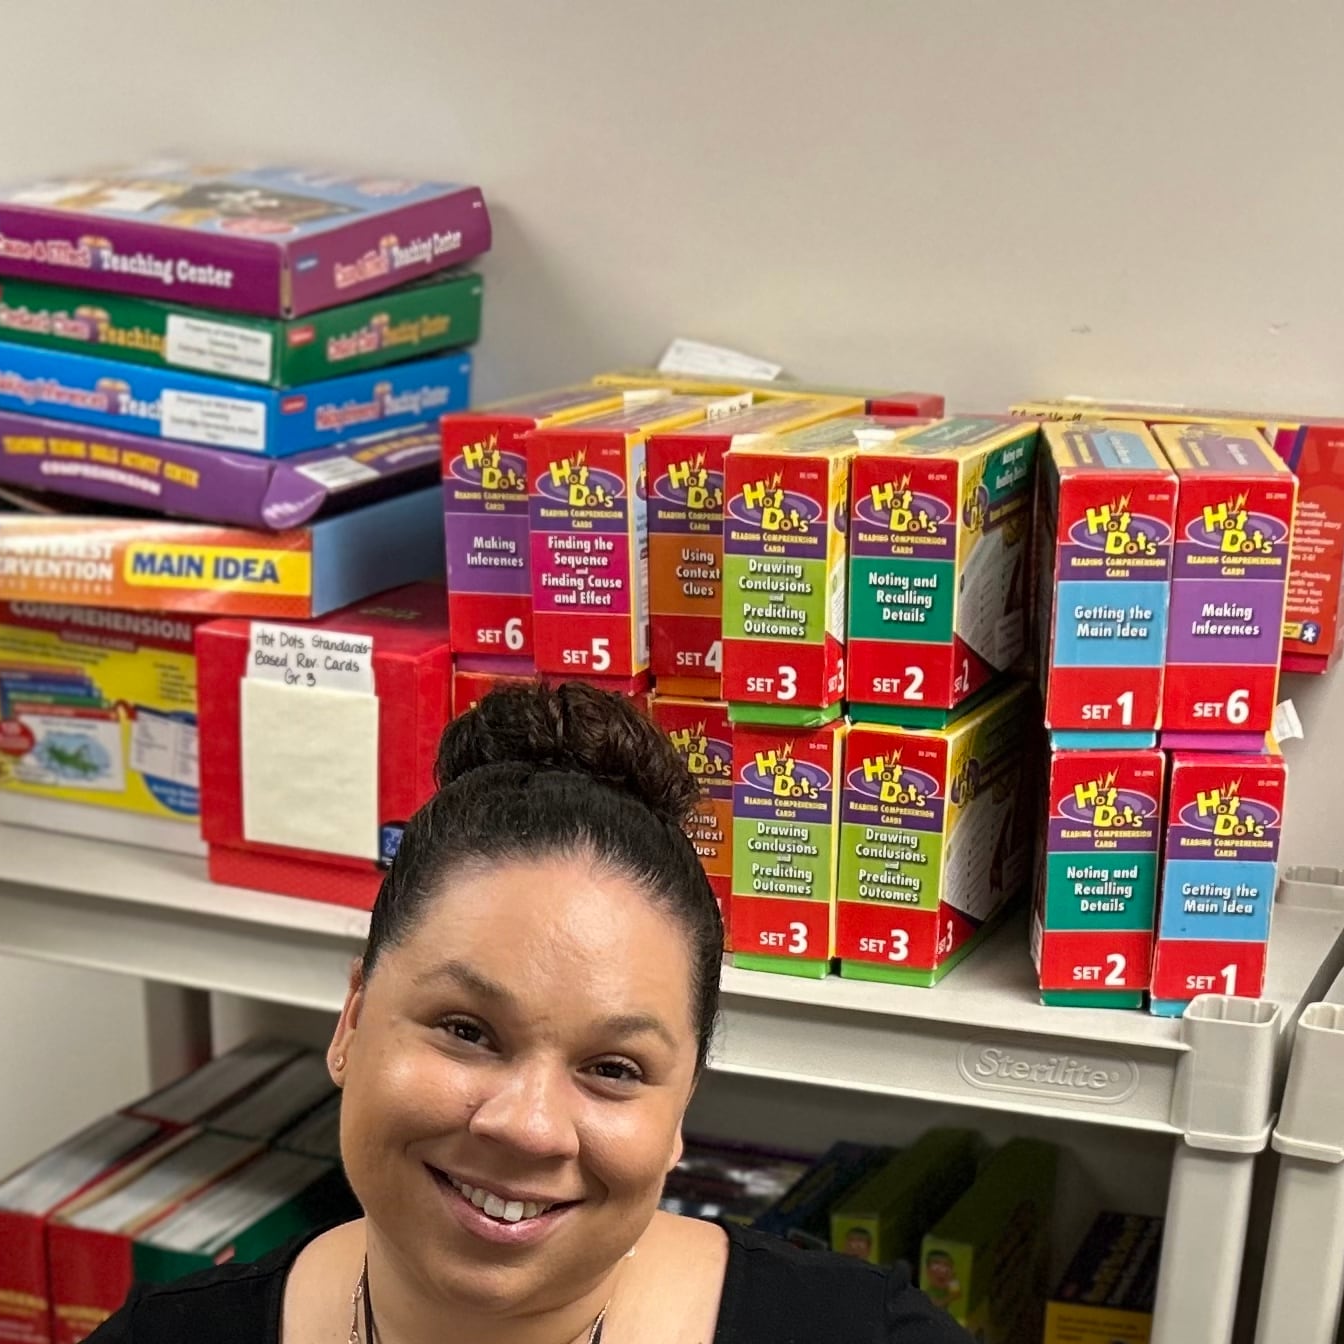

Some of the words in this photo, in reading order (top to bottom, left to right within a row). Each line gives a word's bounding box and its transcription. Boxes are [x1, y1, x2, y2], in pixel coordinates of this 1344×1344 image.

[132, 548, 203, 579] MAIN
[213, 555, 279, 584] IDEA
[748, 560, 802, 578] Drawing
[738, 576, 812, 593] Conclusions
[743, 604, 807, 623] Predicting
[1074, 605, 1125, 622] Getting
[1129, 606, 1152, 620] the
[744, 621, 805, 636] Outcomes
[1076, 623, 1112, 637] Main
[1117, 624, 1148, 638] Idea
[256, 629, 275, 647] Hot
[280, 632, 304, 648] Dots
[255, 650, 288, 666] Based
[324, 656, 359, 672] Cards
[746, 677, 774, 692] SET
[777, 667, 797, 699] 3
[1081, 705, 1111, 720] SET
[1117, 691, 1134, 725] 1
[1067, 866, 1110, 882] Noting
[1113, 866, 1138, 880] and
[1074, 882, 1133, 898] Recalling
[1080, 899, 1125, 912] Details
[1073, 966, 1101, 980] SET
[1105, 953, 1126, 985] 2
[976, 1048, 1114, 1089] Sterilite
